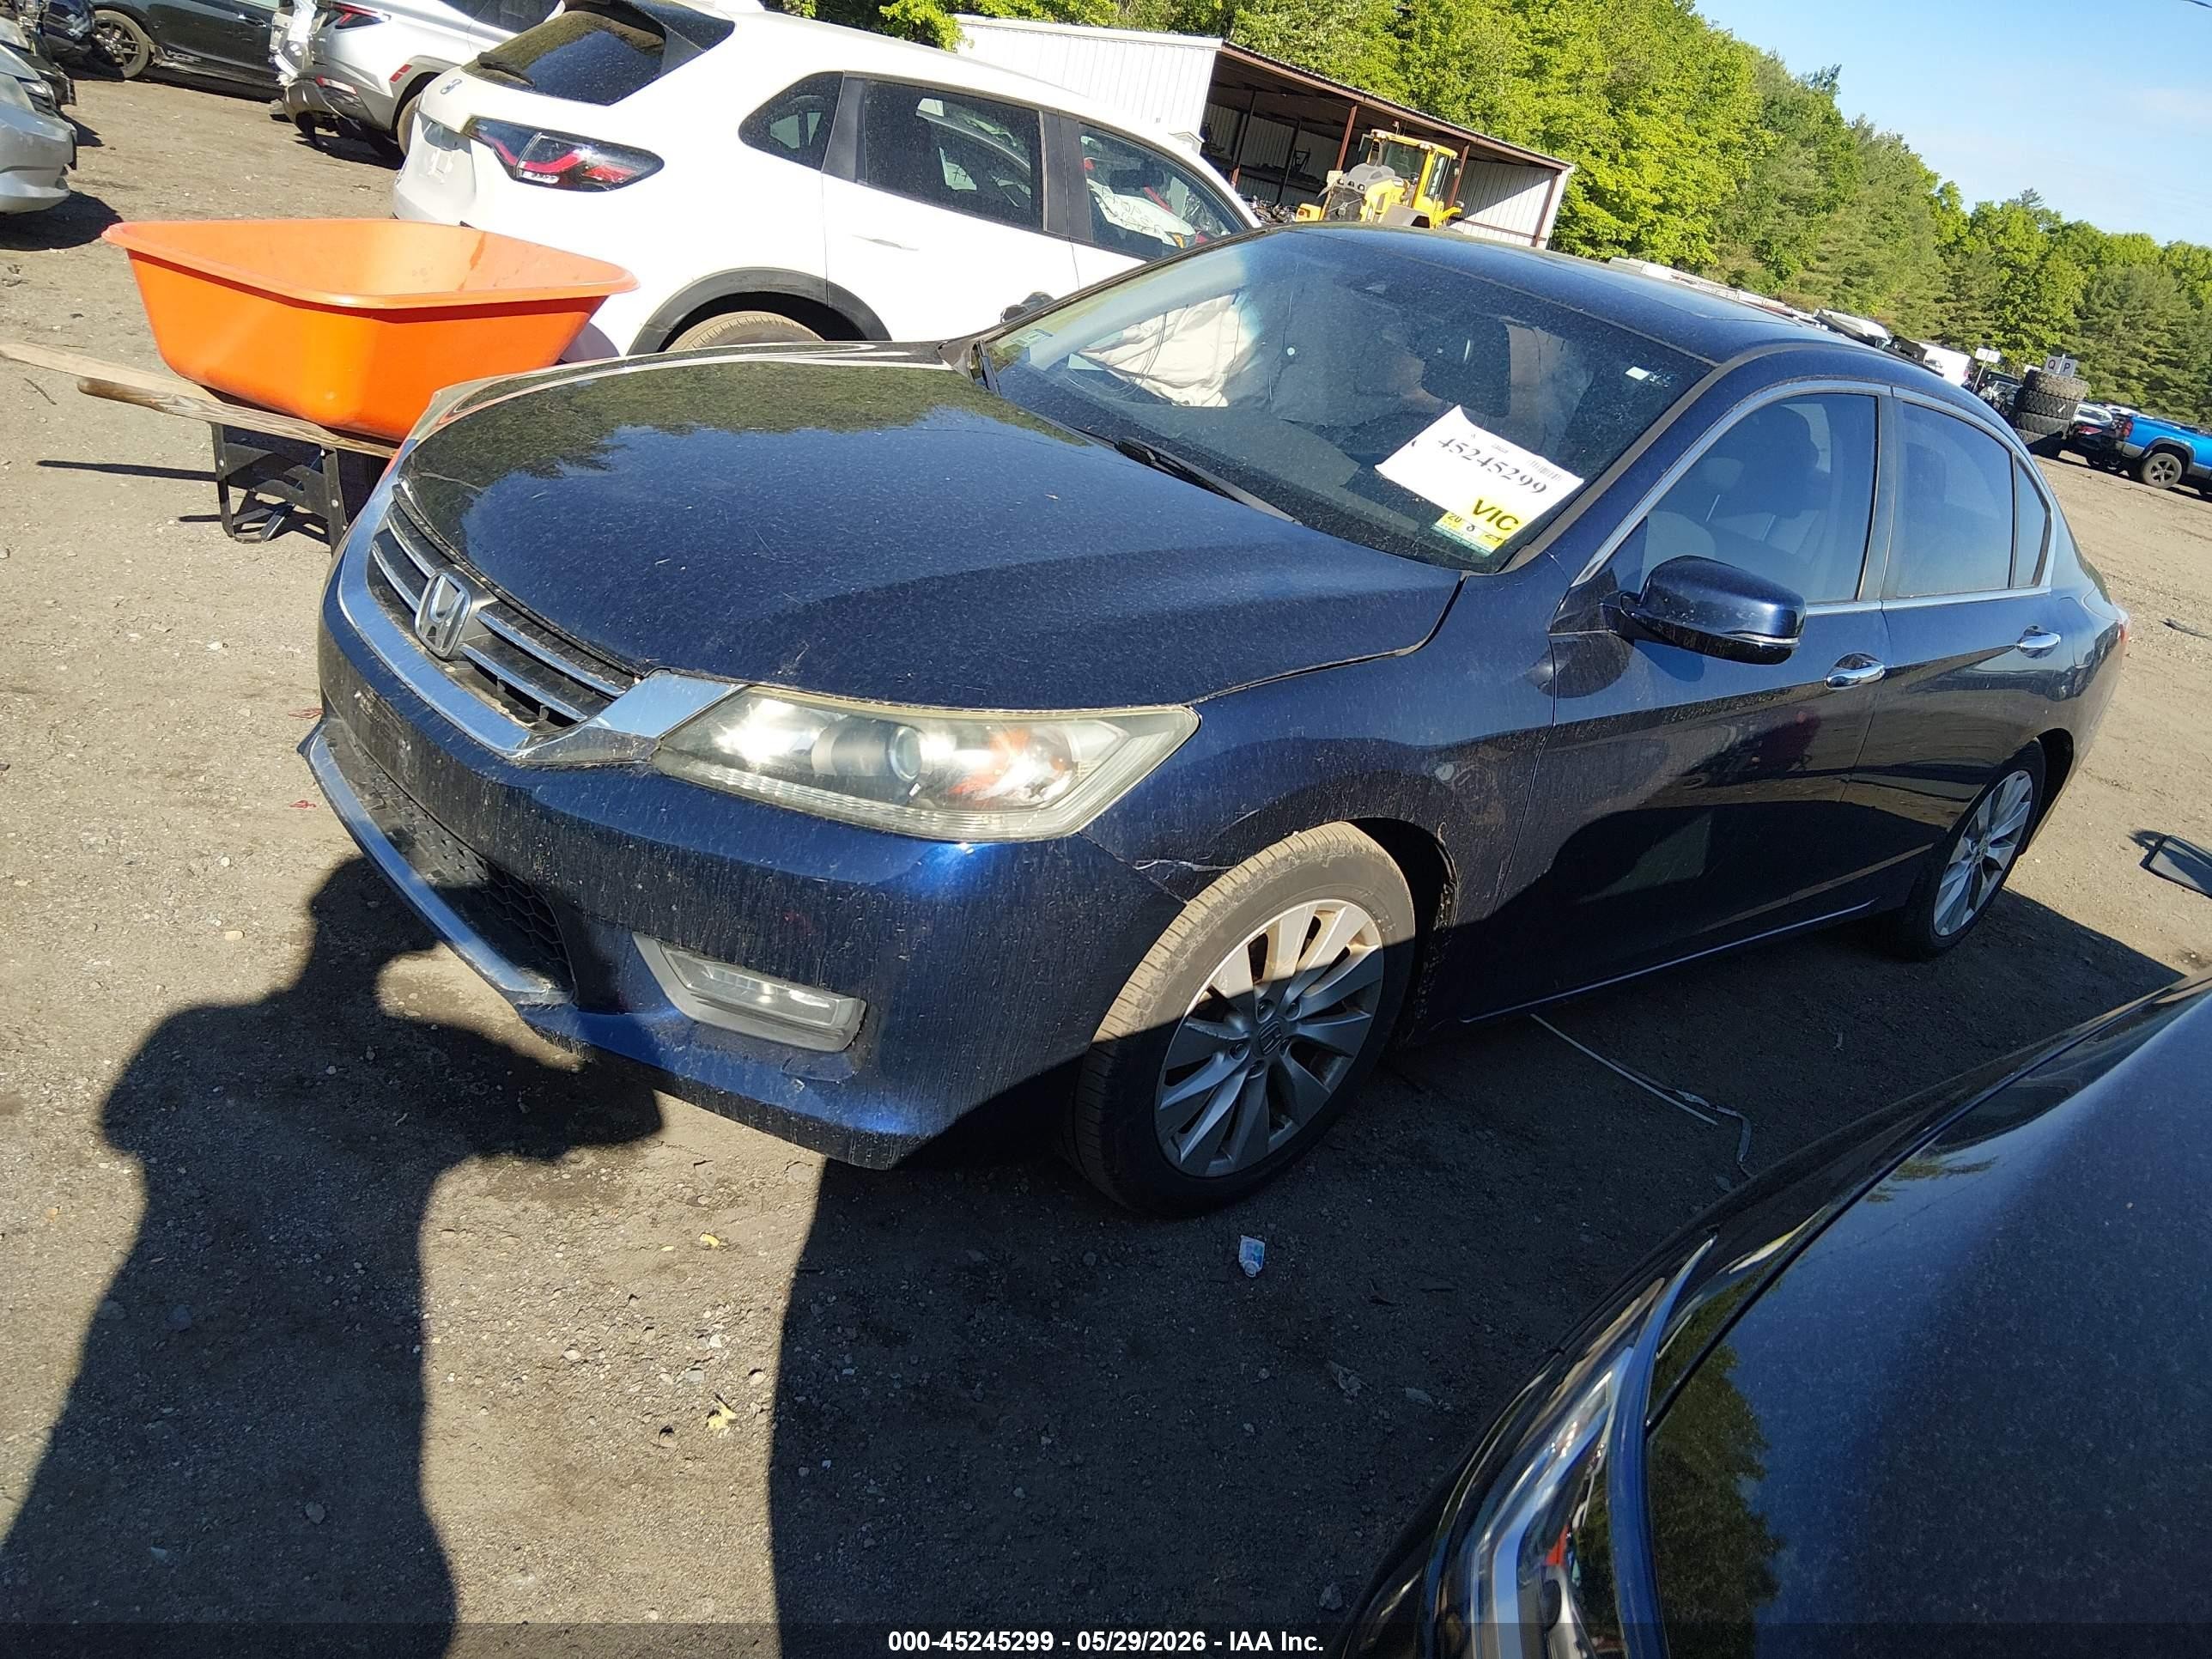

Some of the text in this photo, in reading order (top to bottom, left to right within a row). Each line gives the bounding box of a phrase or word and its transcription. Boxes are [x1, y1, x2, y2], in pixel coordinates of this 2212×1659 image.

[2048, 359, 2070, 372] Q P
[1438, 439, 1547, 493] 45245299
[1473, 499, 1519, 531] VIC
